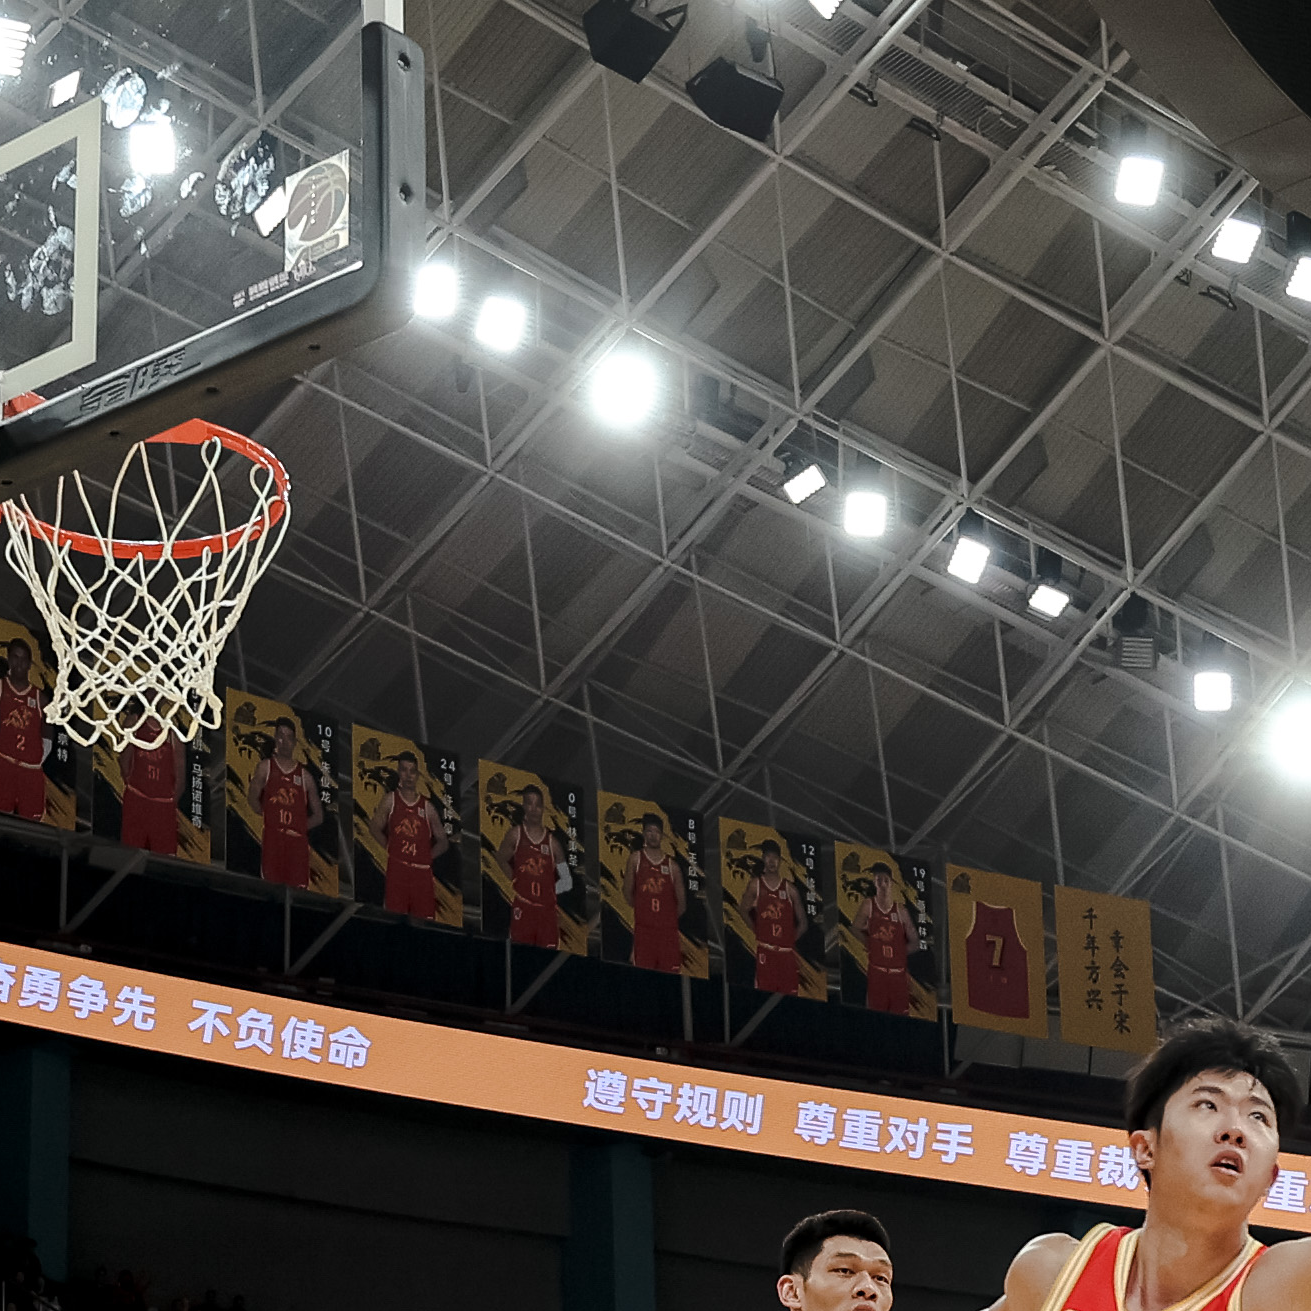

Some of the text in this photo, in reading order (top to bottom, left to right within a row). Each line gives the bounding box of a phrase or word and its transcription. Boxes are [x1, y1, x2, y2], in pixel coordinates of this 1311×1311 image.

[985, 934, 1005, 969] 7
[187, 1000, 372, 1070] 不负使命
[582, 1068, 765, 1136] 遵守规则
[794, 1100, 976, 1164] 尊重对手
